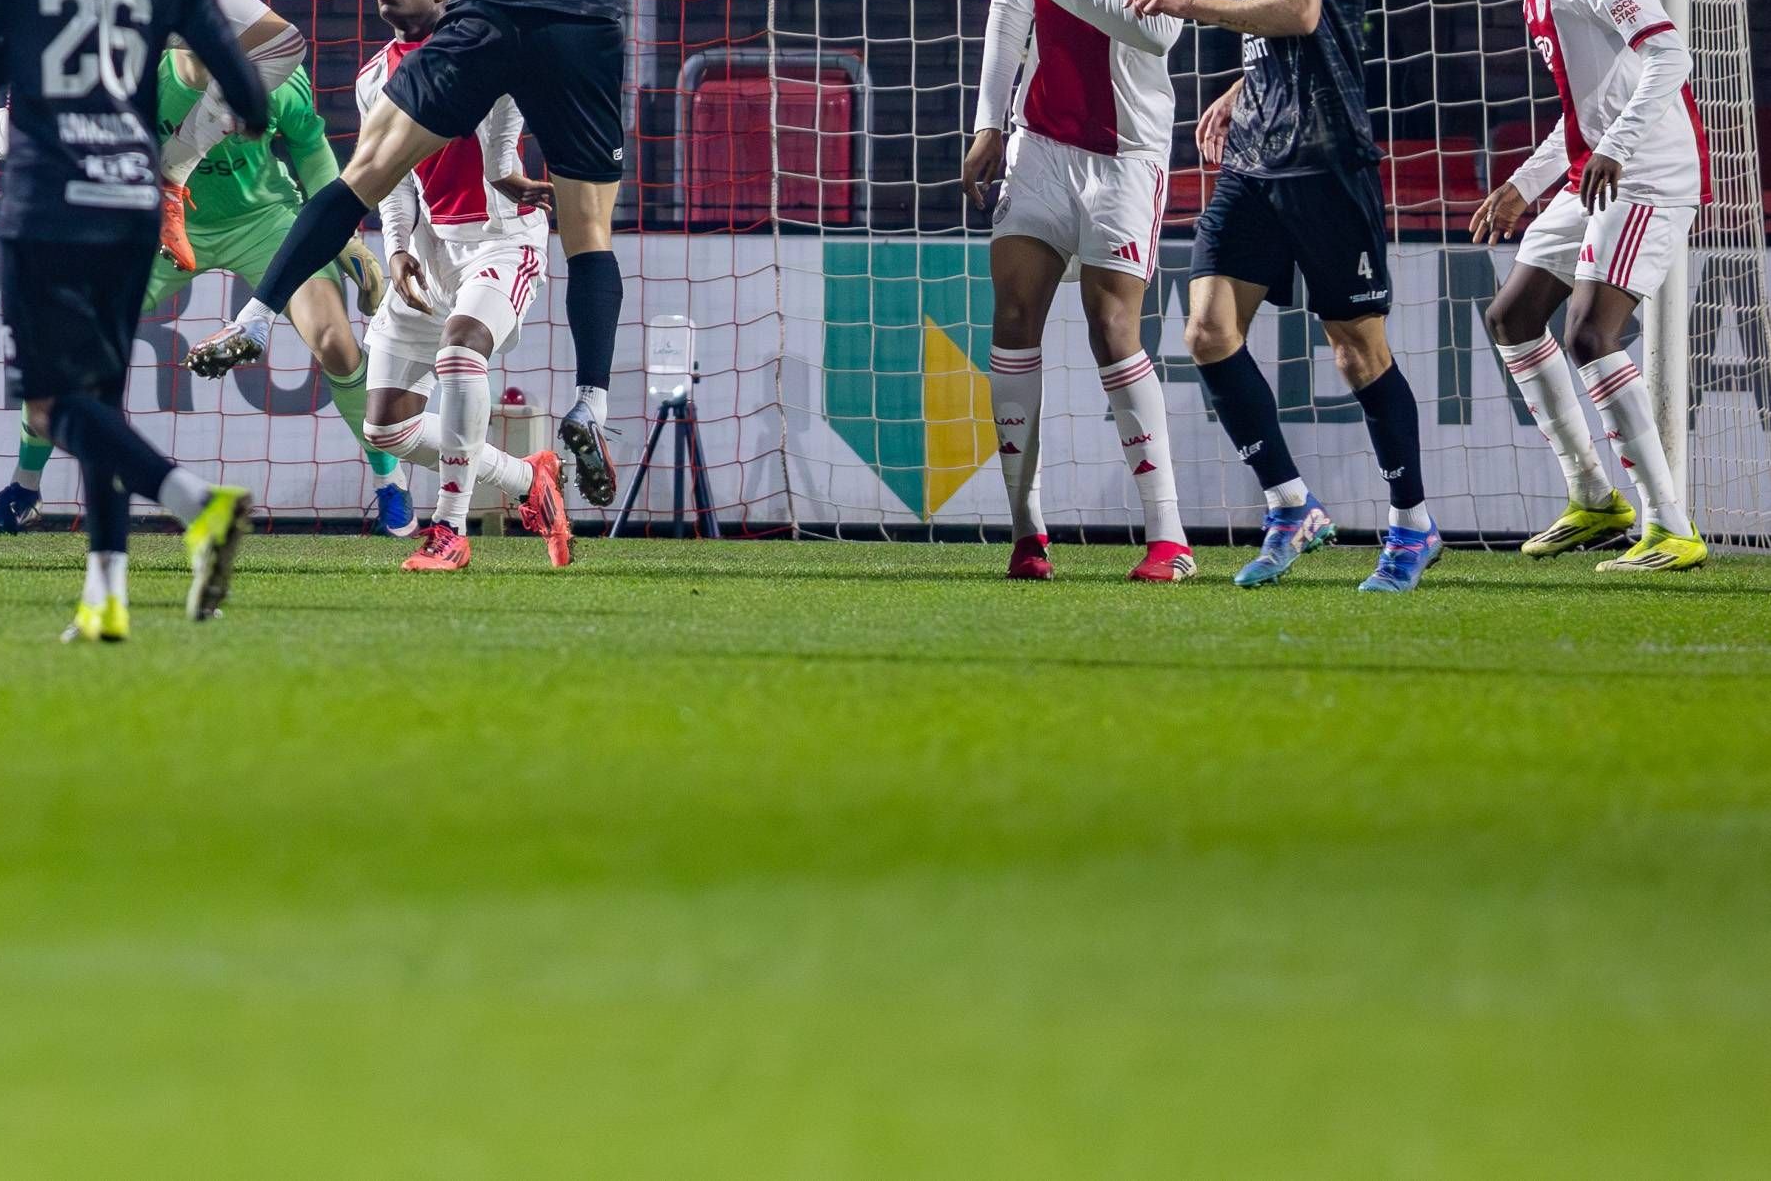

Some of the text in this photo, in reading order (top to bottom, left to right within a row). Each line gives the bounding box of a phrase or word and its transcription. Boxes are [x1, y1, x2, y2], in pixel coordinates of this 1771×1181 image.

[1610, 0, 1636, 17] ROCK
[1615, 5, 1641, 26] STARS
[1357, 251, 1373, 279] 4
